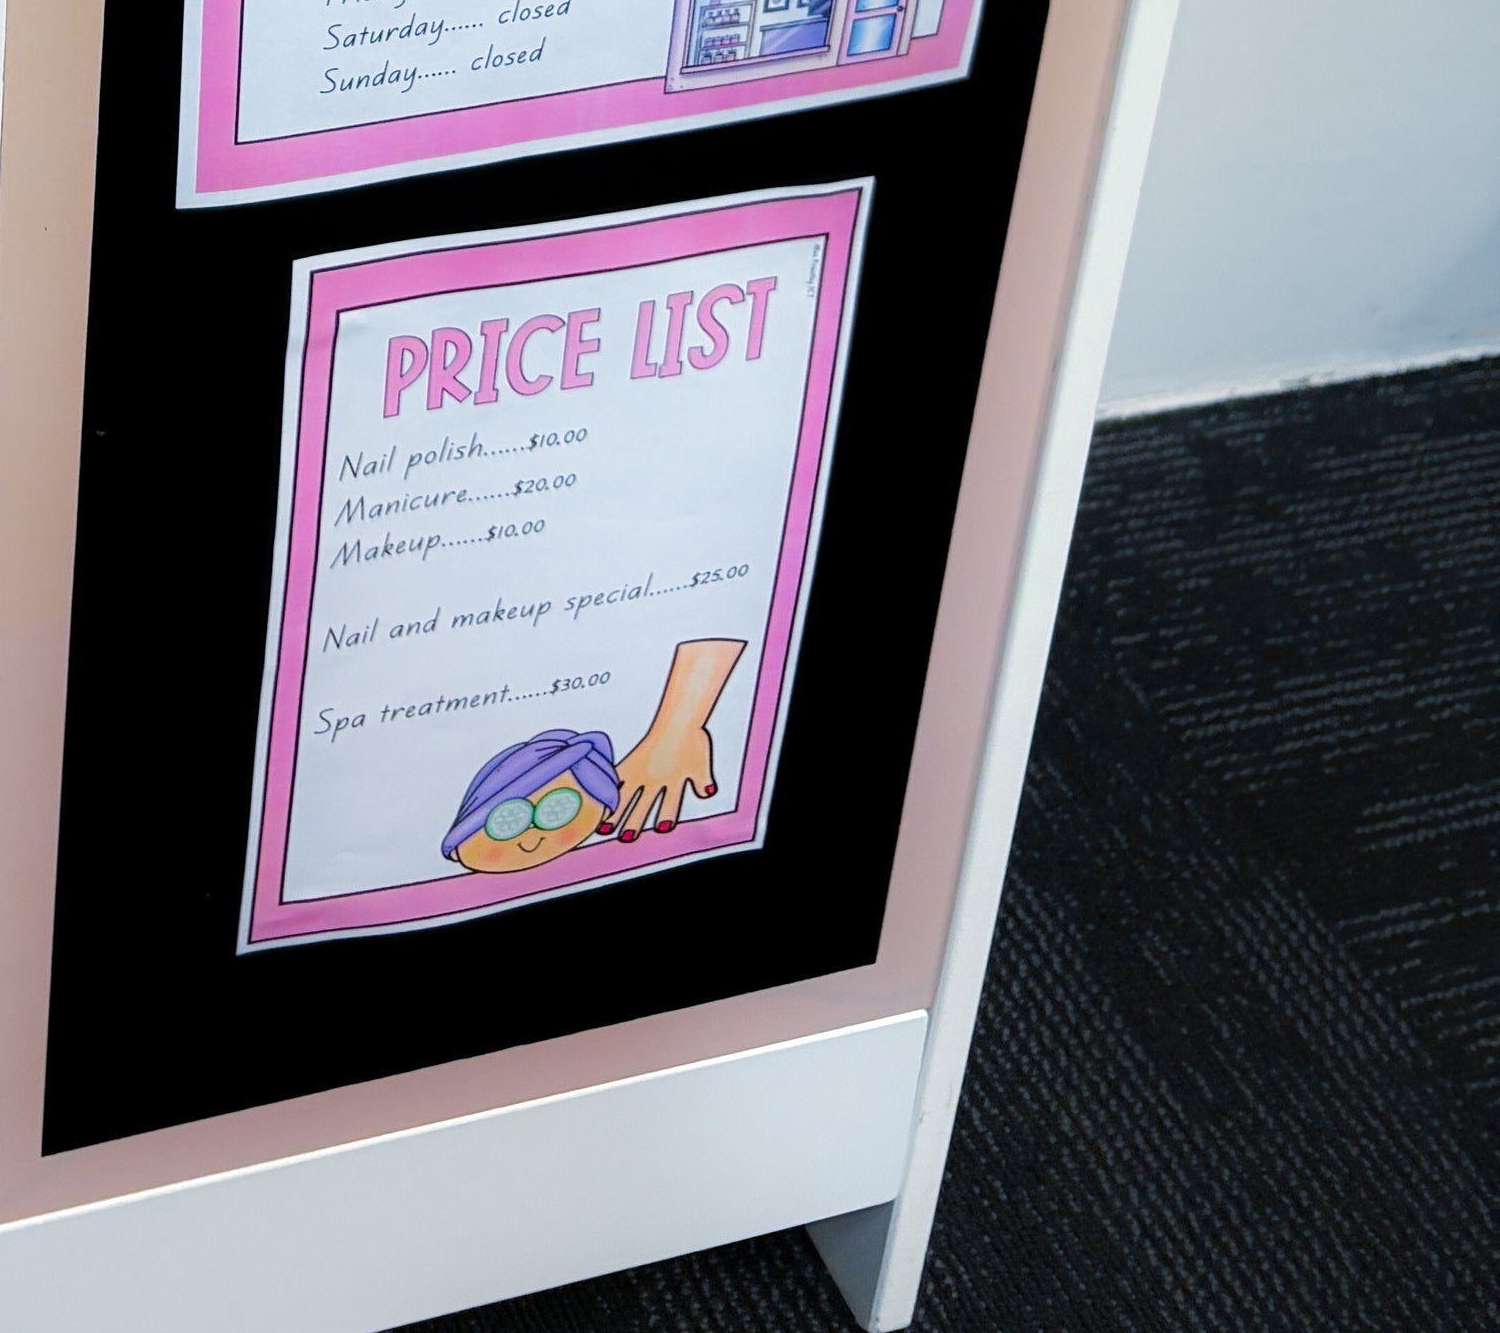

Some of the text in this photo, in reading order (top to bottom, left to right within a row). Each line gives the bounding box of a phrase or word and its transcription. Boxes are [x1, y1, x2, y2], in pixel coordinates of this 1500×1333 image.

[470, 36, 547, 72] closed
[382, 276, 777, 418] PRICE LIST
[339, 445, 396, 481] Nail
[322, 617, 378, 653] Nail
[389, 607, 440, 639] and
[451, 597, 551, 627] makeup
[313, 708, 365, 743] Spa
